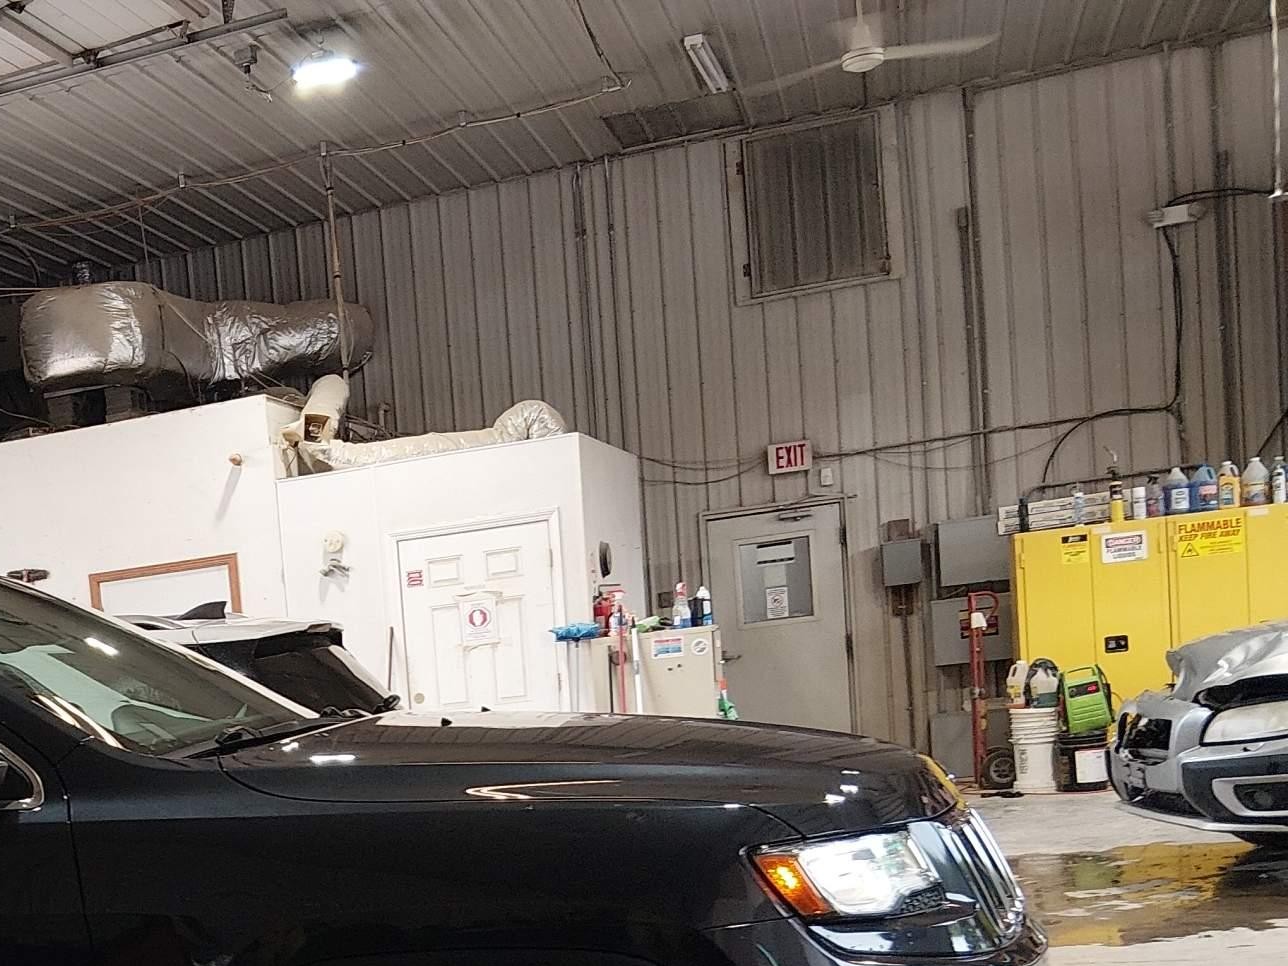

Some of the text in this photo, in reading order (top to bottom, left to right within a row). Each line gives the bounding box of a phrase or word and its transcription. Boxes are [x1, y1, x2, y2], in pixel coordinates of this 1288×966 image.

[775, 443, 807, 469] EXIT
[1178, 518, 1241, 534] FLAMMABLE
[1178, 528, 1241, 543] KEEP FIRE AWAY
